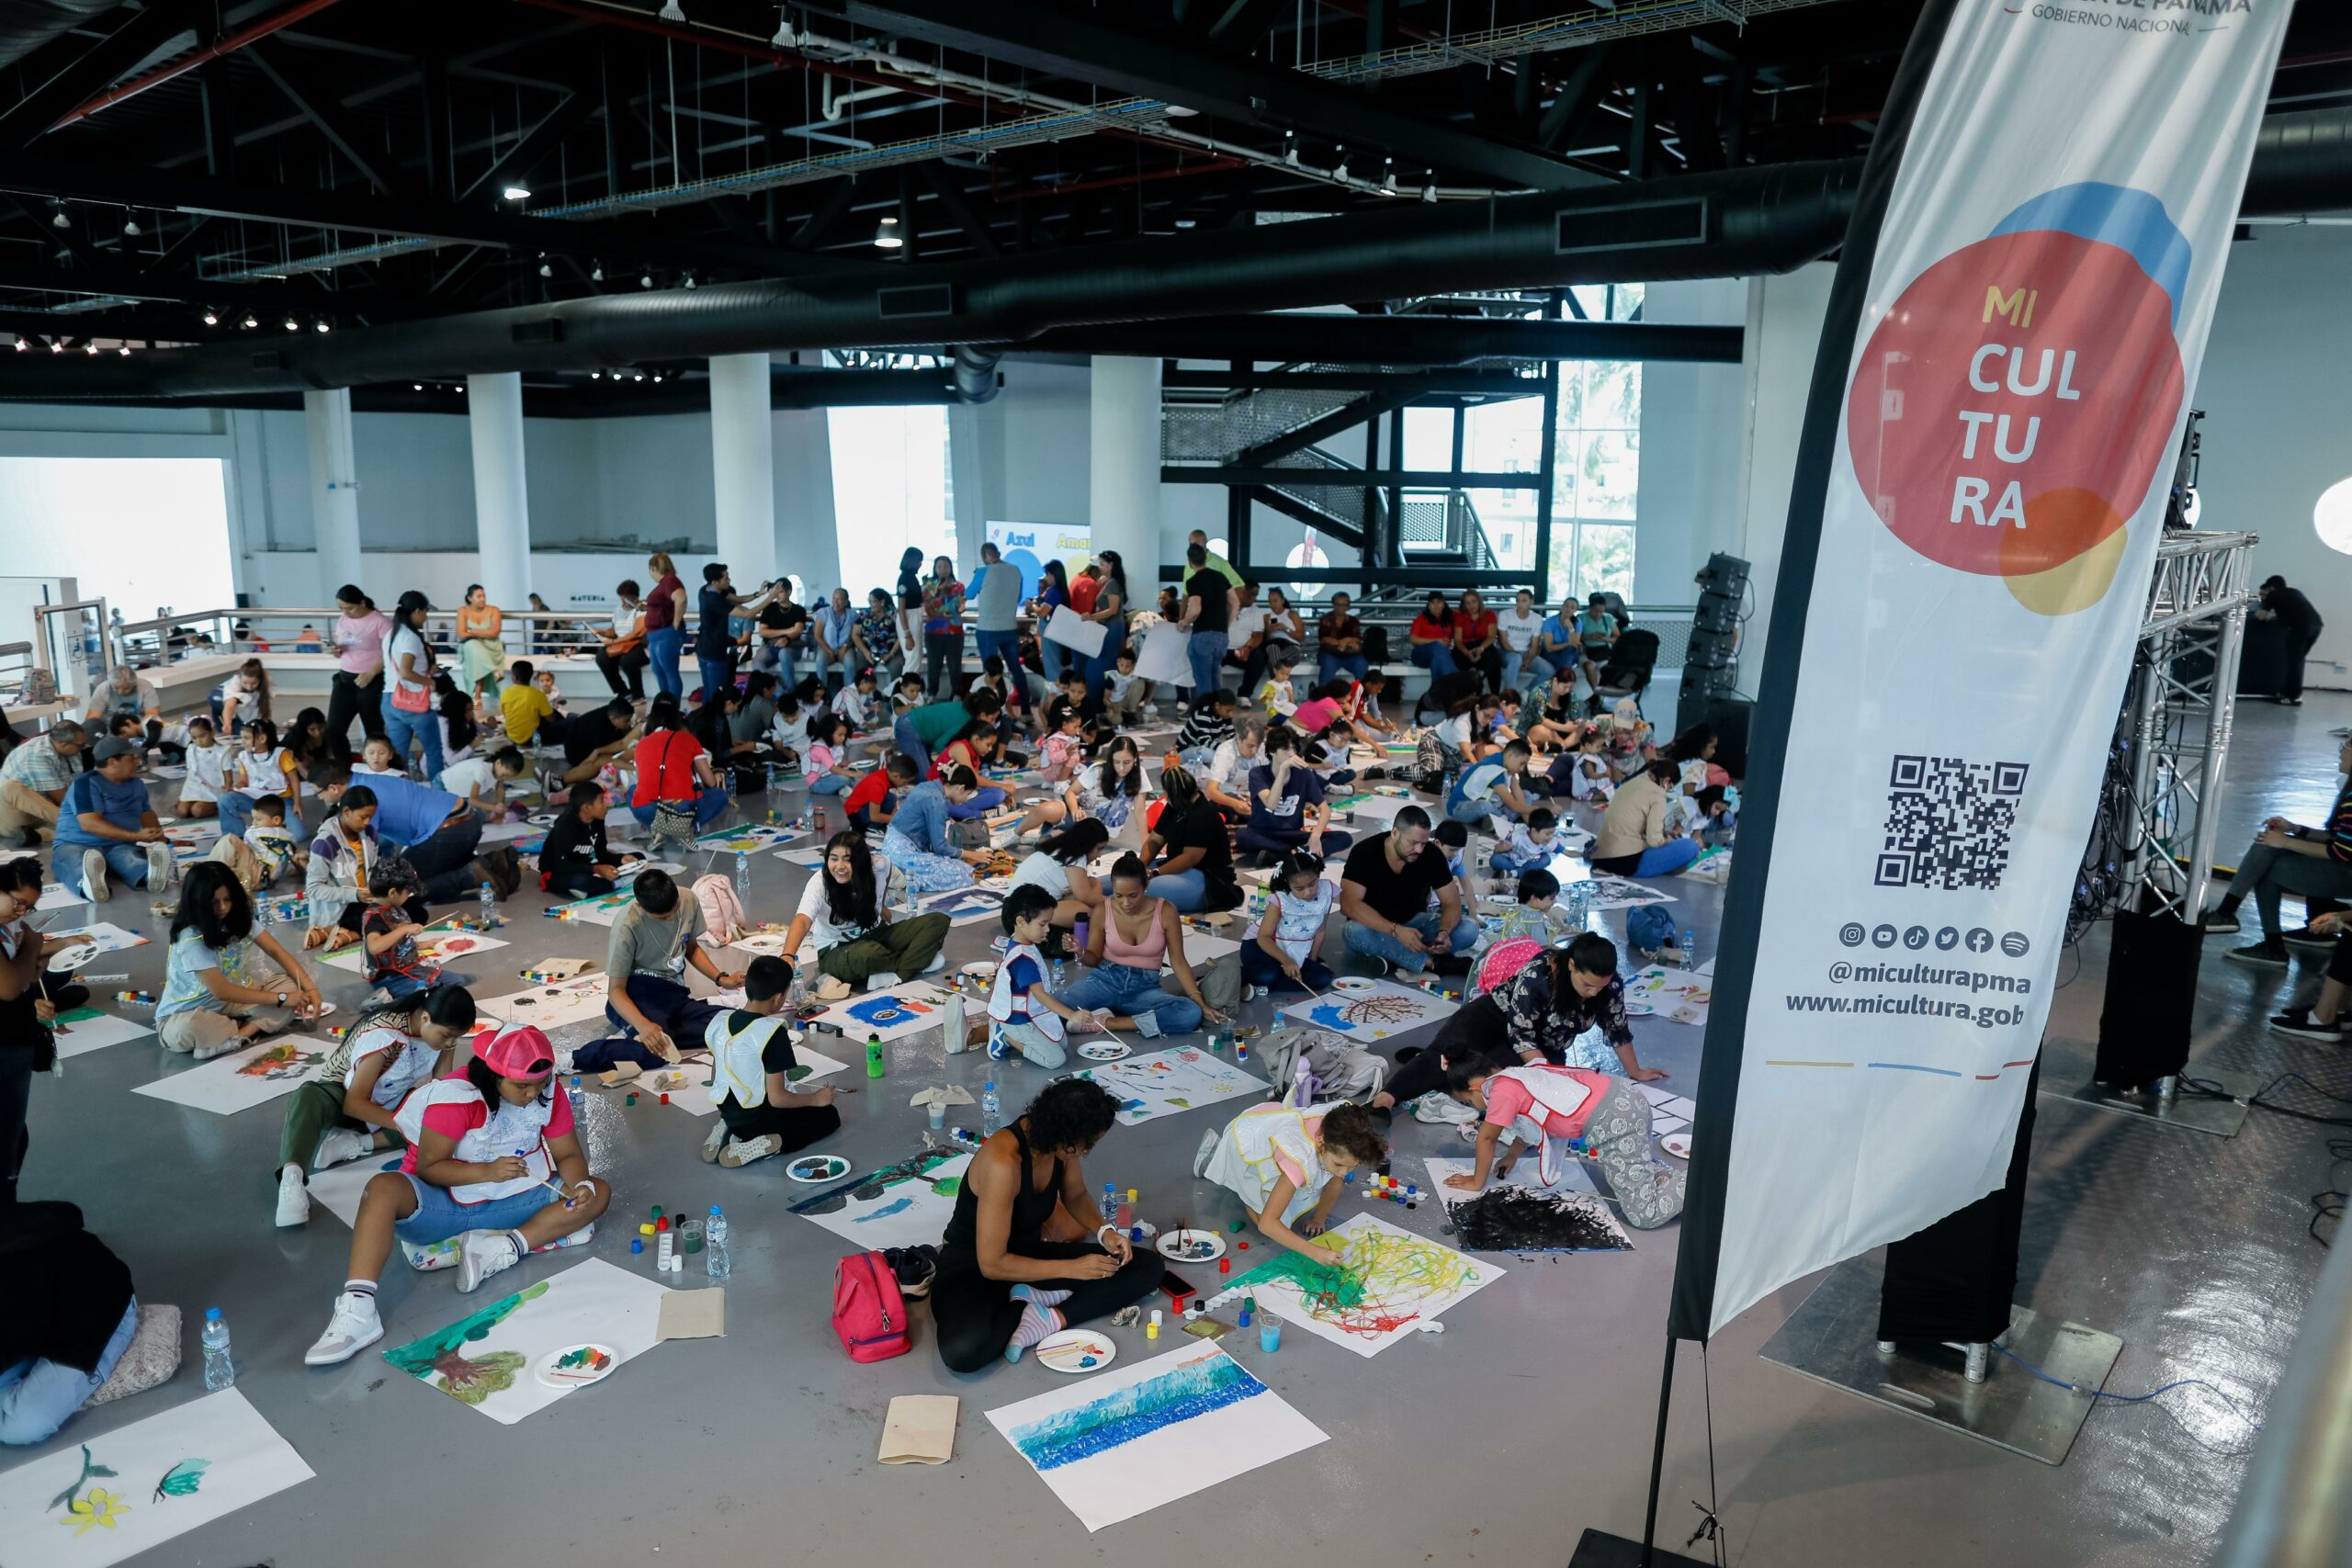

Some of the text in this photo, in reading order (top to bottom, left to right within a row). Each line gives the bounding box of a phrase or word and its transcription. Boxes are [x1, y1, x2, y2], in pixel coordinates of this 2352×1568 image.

[2031, 4, 2191, 36] GOBIERNO NACIONA
[1982, 285, 2039, 328] MI
[1969, 344, 2081, 400] CUL
[1959, 410, 2041, 464] TU
[1950, 476, 2027, 529] RA
[1006, 531, 1035, 547] Azul
[1828, 960, 2031, 995] @miculturapma
[1785, 993, 2024, 1029] www.micultura.gob
